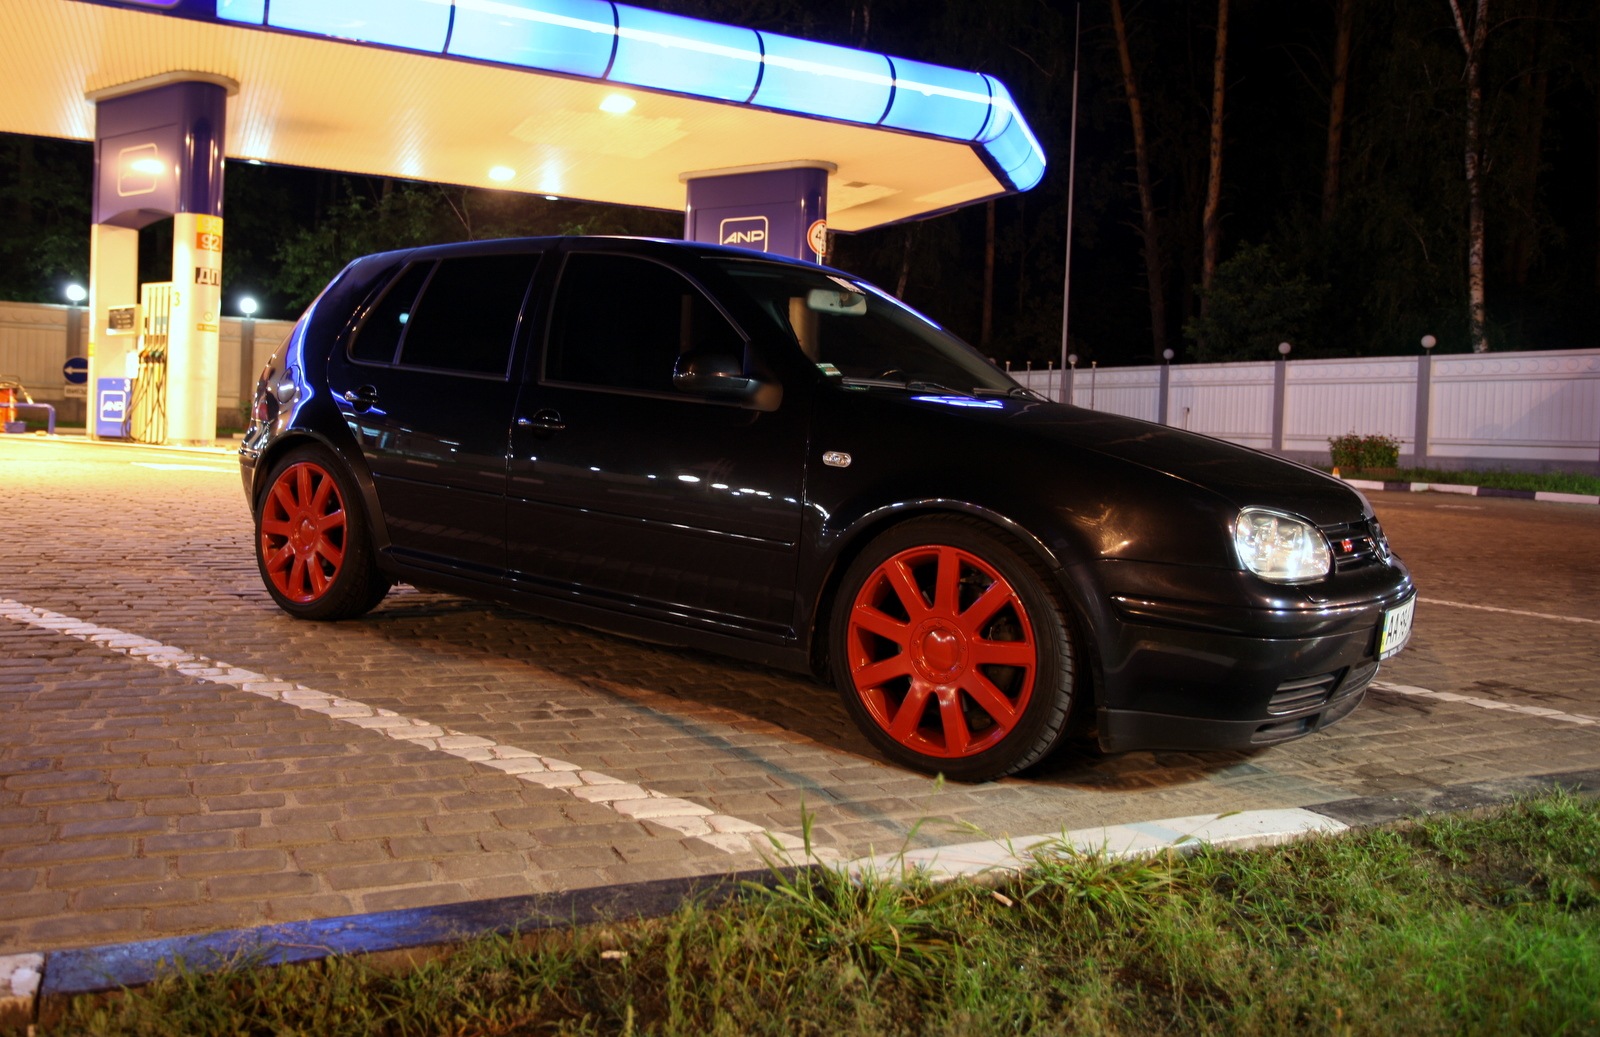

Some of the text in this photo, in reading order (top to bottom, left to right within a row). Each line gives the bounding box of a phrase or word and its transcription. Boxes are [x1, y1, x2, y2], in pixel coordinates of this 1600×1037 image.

[201, 234, 219, 251] 92
[724, 231, 764, 244] ANP
[197, 268, 219, 286] ДП
[174, 292, 181, 307] 3
[124, 379, 131, 393] 3
[102, 401, 125, 411] ANP
